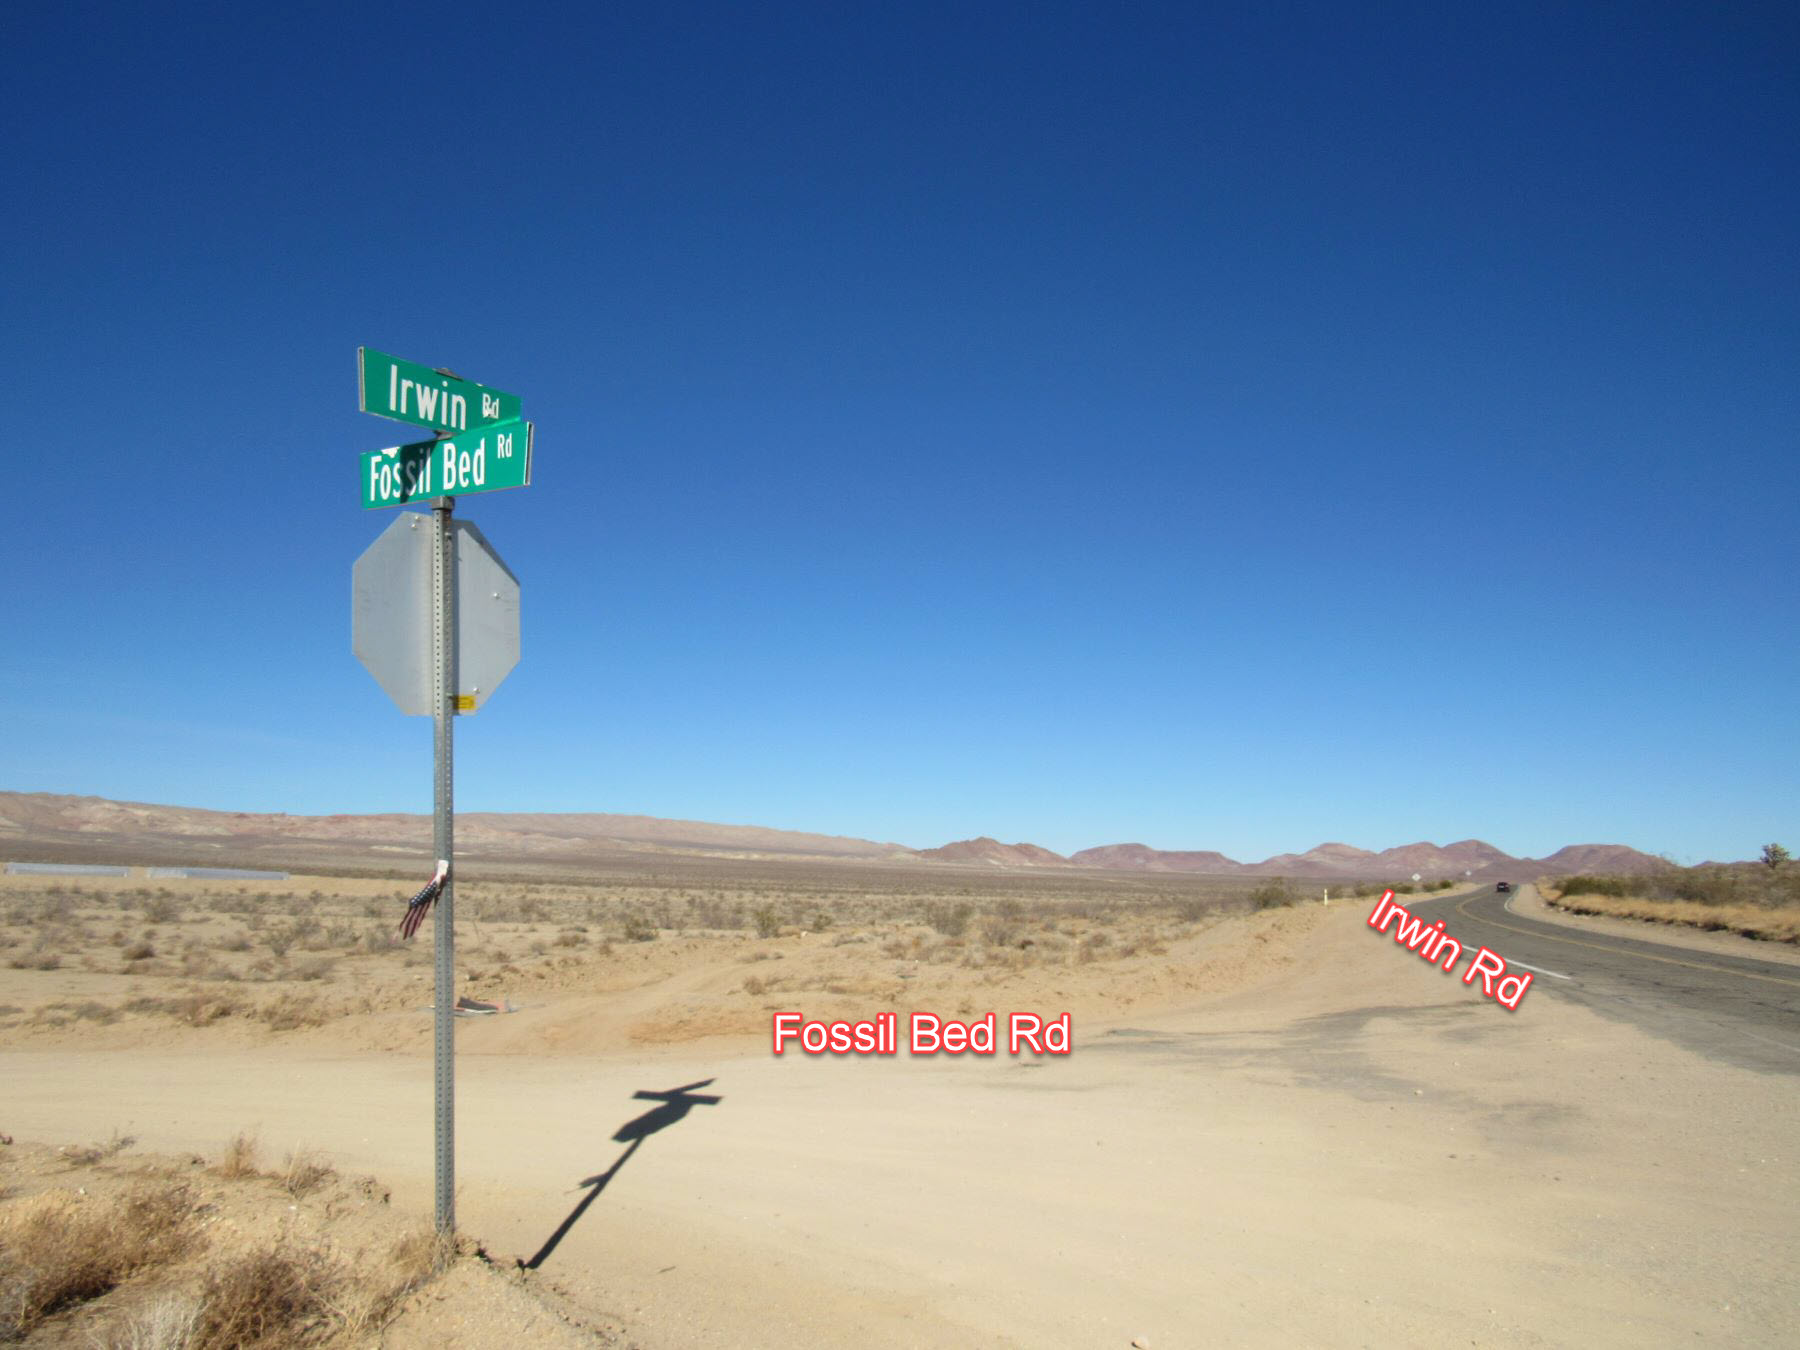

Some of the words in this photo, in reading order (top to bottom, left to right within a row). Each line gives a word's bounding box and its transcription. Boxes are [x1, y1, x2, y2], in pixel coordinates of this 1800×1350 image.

[389, 364, 467, 431] Irwin
[369, 448, 431, 502] Fossil
[443, 437, 486, 490] Bed
[497, 433, 513, 459] Rd
